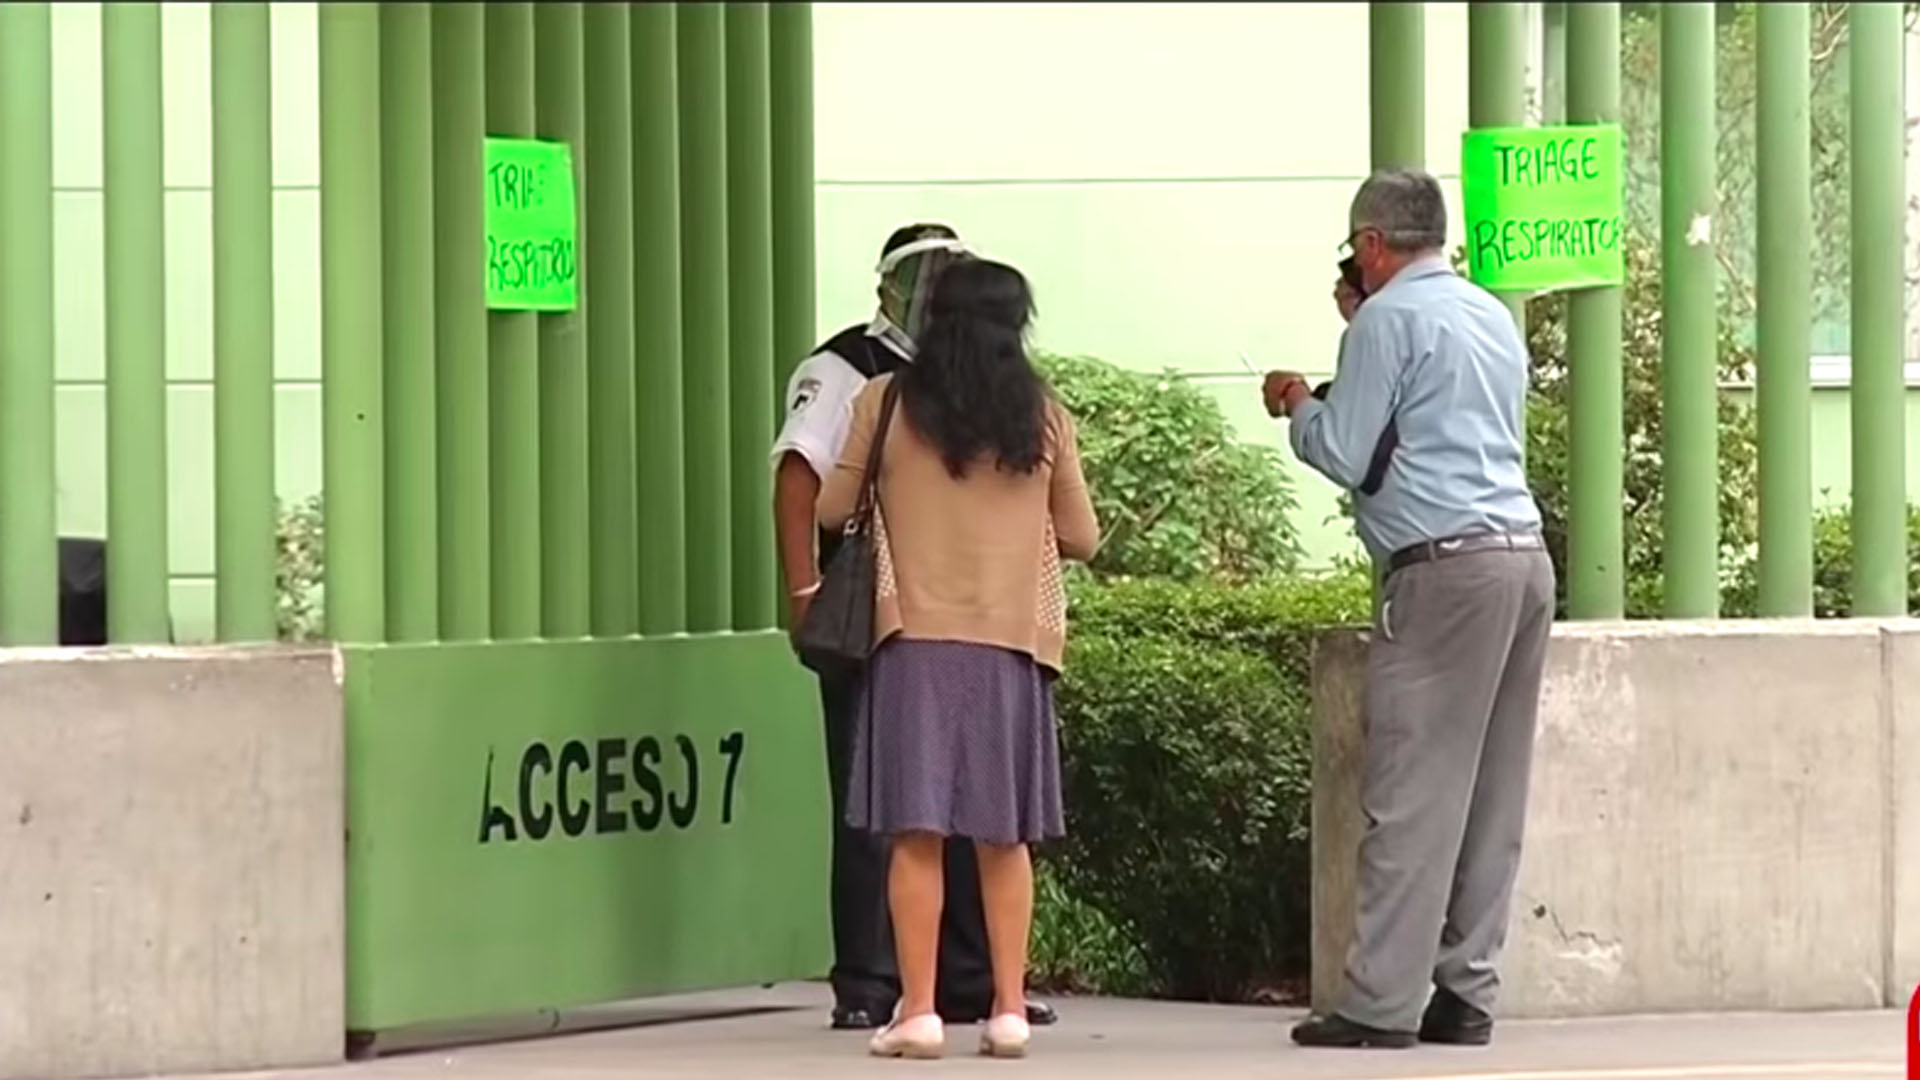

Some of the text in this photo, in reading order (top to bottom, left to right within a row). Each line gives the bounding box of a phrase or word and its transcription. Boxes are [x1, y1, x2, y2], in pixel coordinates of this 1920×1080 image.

[1493, 137, 1599, 187] TRIAGE
[478, 731, 744, 843] ACCESO 7
